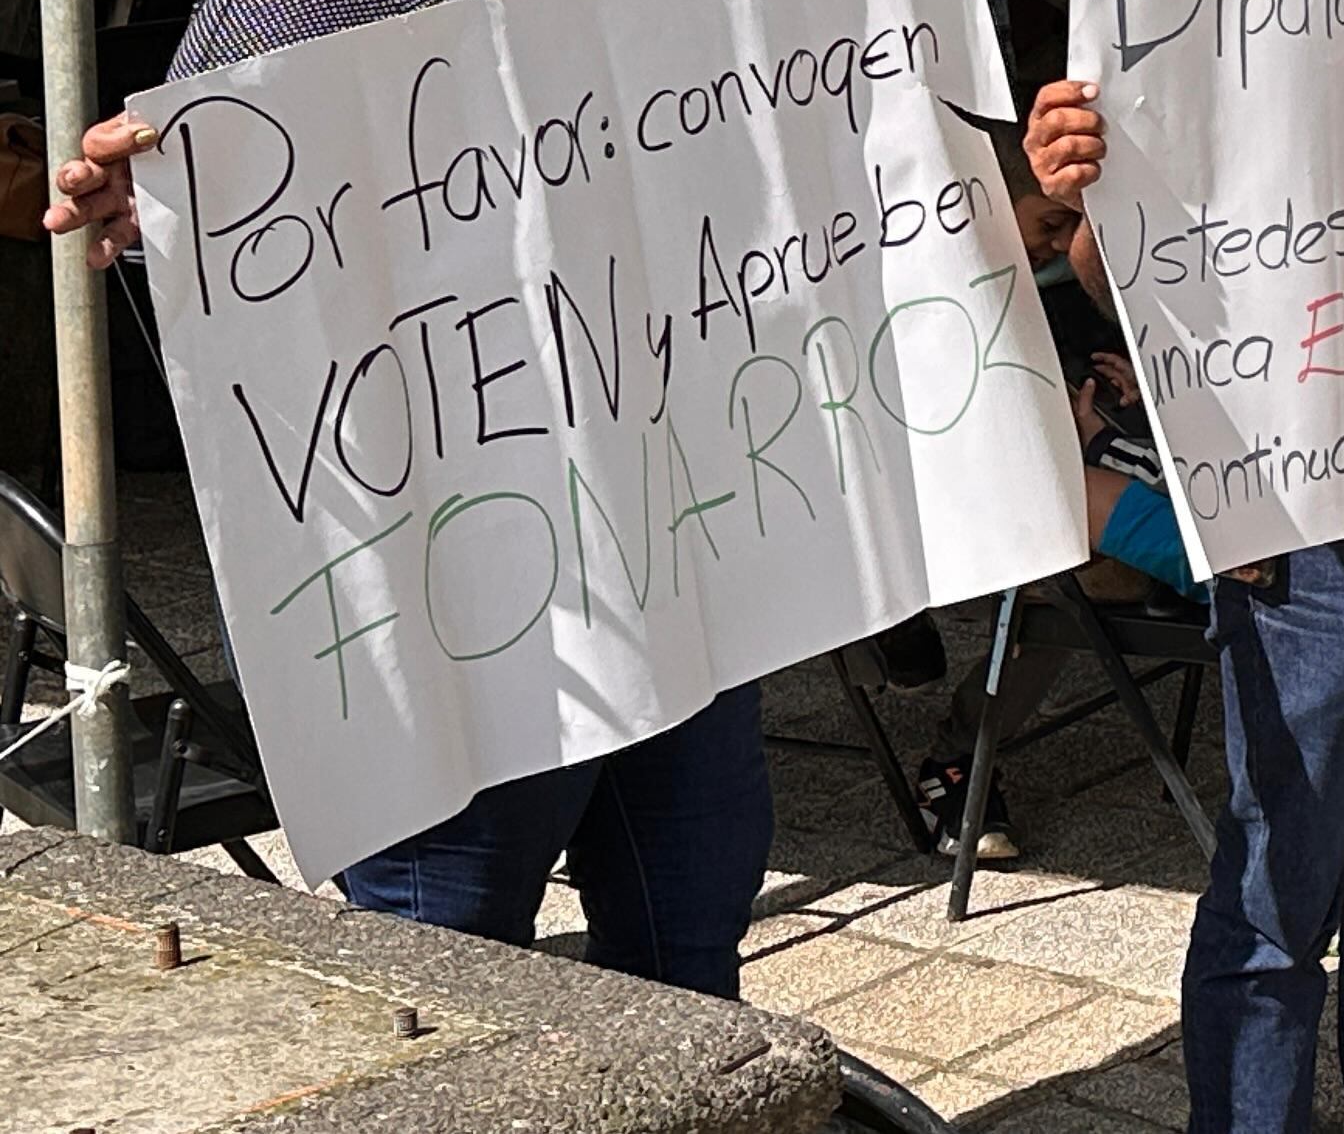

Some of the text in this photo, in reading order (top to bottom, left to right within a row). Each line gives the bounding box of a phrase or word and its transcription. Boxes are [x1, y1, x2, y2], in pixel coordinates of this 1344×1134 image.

[157, 21, 941, 316] Por favor: convoqen
[232, 164, 993, 523] VOTEN y Aprueben
[269, 264, 1057, 721] FONARROZ
